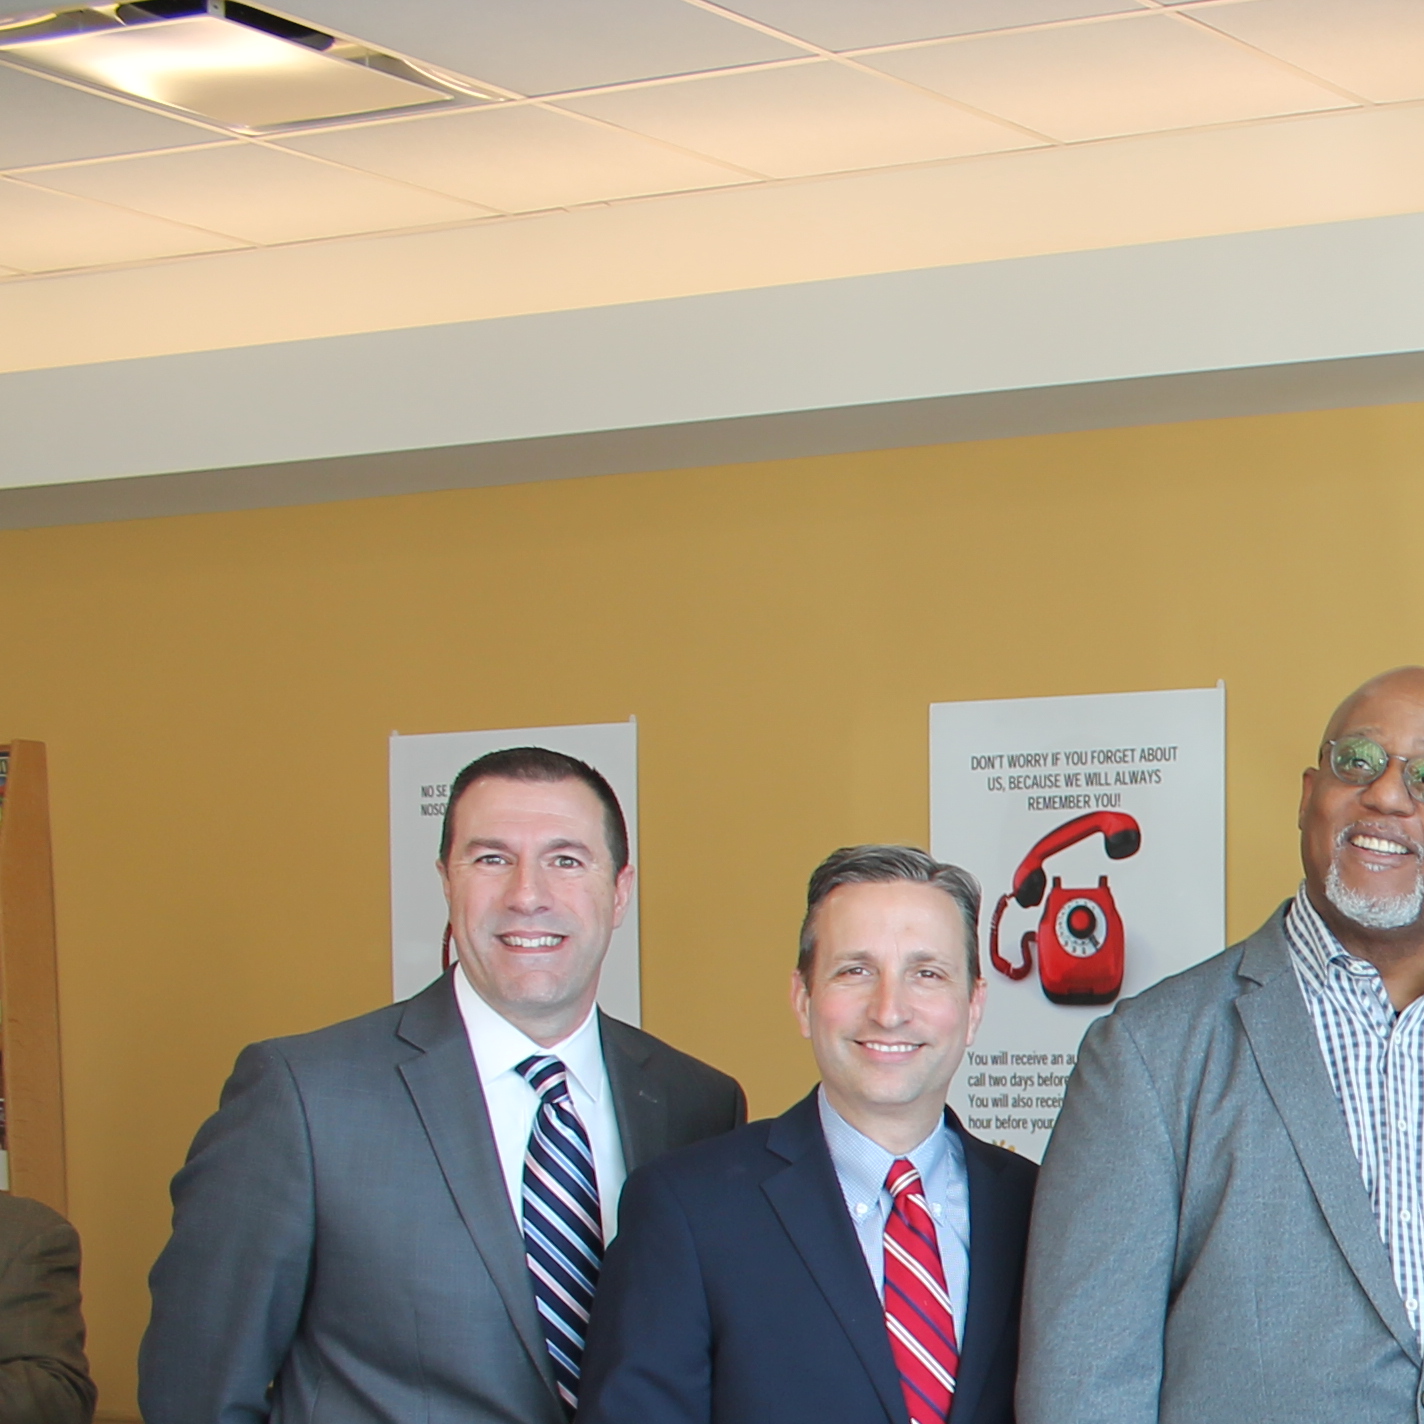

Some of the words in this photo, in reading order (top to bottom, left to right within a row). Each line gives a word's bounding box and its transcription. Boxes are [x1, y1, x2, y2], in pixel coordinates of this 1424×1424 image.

[971, 754, 1004, 770] DON'T
[1007, 754, 1048, 769] WORRY
[1051, 752, 1061, 766] IF
[1064, 751, 1087, 765] YOU
[1091, 749, 1135, 764] FORGET
[1139, 746, 1178, 762] ABOUT
[987, 777, 1005, 791] US,
[1009, 775, 1060, 789] BECAUSE
[1064, 773, 1081, 787] WE
[1085, 772, 1110, 786] WILL
[1114, 770, 1161, 785] ALWAYS
[421, 785, 434, 797] NO
[436, 785, 447, 797] SE
[421, 803, 446, 815] NOSO
[1028, 795, 1091, 810] REMEMBER
[1094, 793, 1120, 807] YOU!
[967, 1051, 988, 1065] You
[991, 1051, 1008, 1065] will
[1011, 1051, 1048, 1065] receive
[1050, 1054, 1063, 1065] an
[968, 1073, 985, 1087] call
[989, 1074, 1007, 1086] two
[1010, 1072, 1034, 1091] days
[968, 1094, 988, 1108] You
[991, 1094, 1008, 1107] will
[1012, 1094, 1033, 1108] also
[969, 1115, 992, 1128] hour
[995, 1115, 1027, 1129] before
[1031, 1119, 1054, 1134] your
